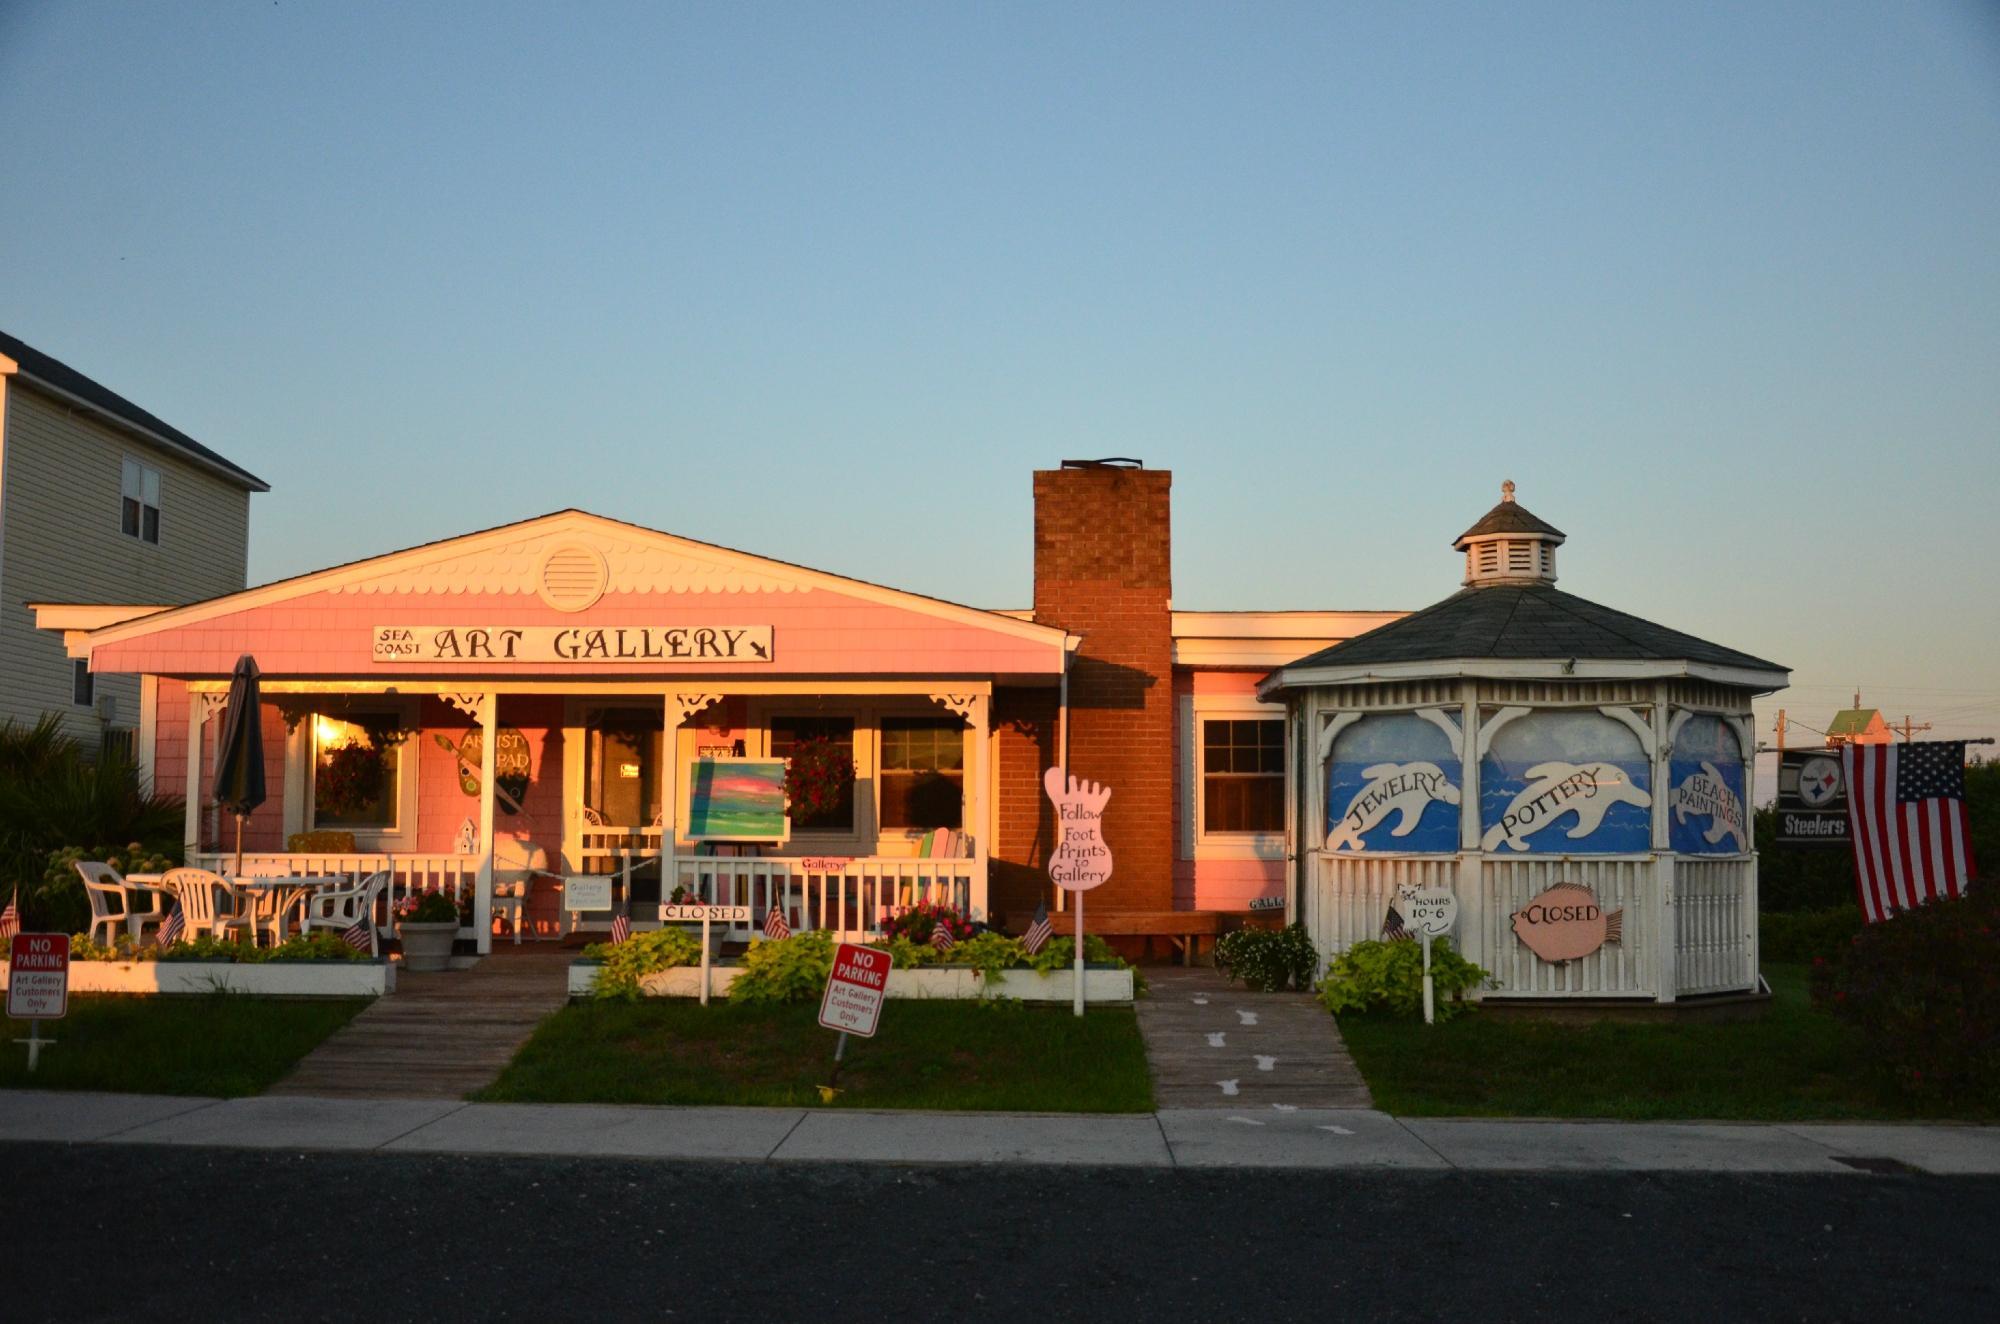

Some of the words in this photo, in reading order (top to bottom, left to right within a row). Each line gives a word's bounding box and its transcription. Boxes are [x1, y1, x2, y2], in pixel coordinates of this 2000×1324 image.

[379, 629, 414, 642] SEA
[433, 628, 524, 658] ART
[553, 628, 747, 660] GALLERY
[374, 643, 421, 655] COAST
[496, 753, 530, 768] PAD
[1692, 775, 1736, 808] BEACH
[1346, 771, 1443, 832] JEWELRY
[1501, 767, 1601, 838] POTTERY
[1679, 787, 1742, 828] PAINTINGS
[1060, 803, 1102, 820] Follow
[1784, 813, 1846, 836] Steelers
[1065, 827, 1096, 841] Foot
[1060, 842, 1106, 859] Prints
[1075, 859, 1090, 868] to
[1050, 864, 1106, 882] Gallery
[1415, 897, 1451, 906] HOURS
[665, 905, 745, 919] CLOSED
[1527, 904, 1600, 925] CLOSED
[29, 938, 52, 953] NO
[16, 953, 63, 968] PARKING
[852, 951, 874, 968] NO
[16, 975, 28, 985] Art
[31, 975, 62, 986] Gallery
[836, 962, 882, 986] PARKING
[16, 986, 60, 997] Customers
[833, 984, 846, 995] Art
[848, 988, 876, 1004] Gallery
[27, 998, 48, 1008] Only
[831, 996, 873, 1014] Customers
[840, 1010, 859, 1023] Only
